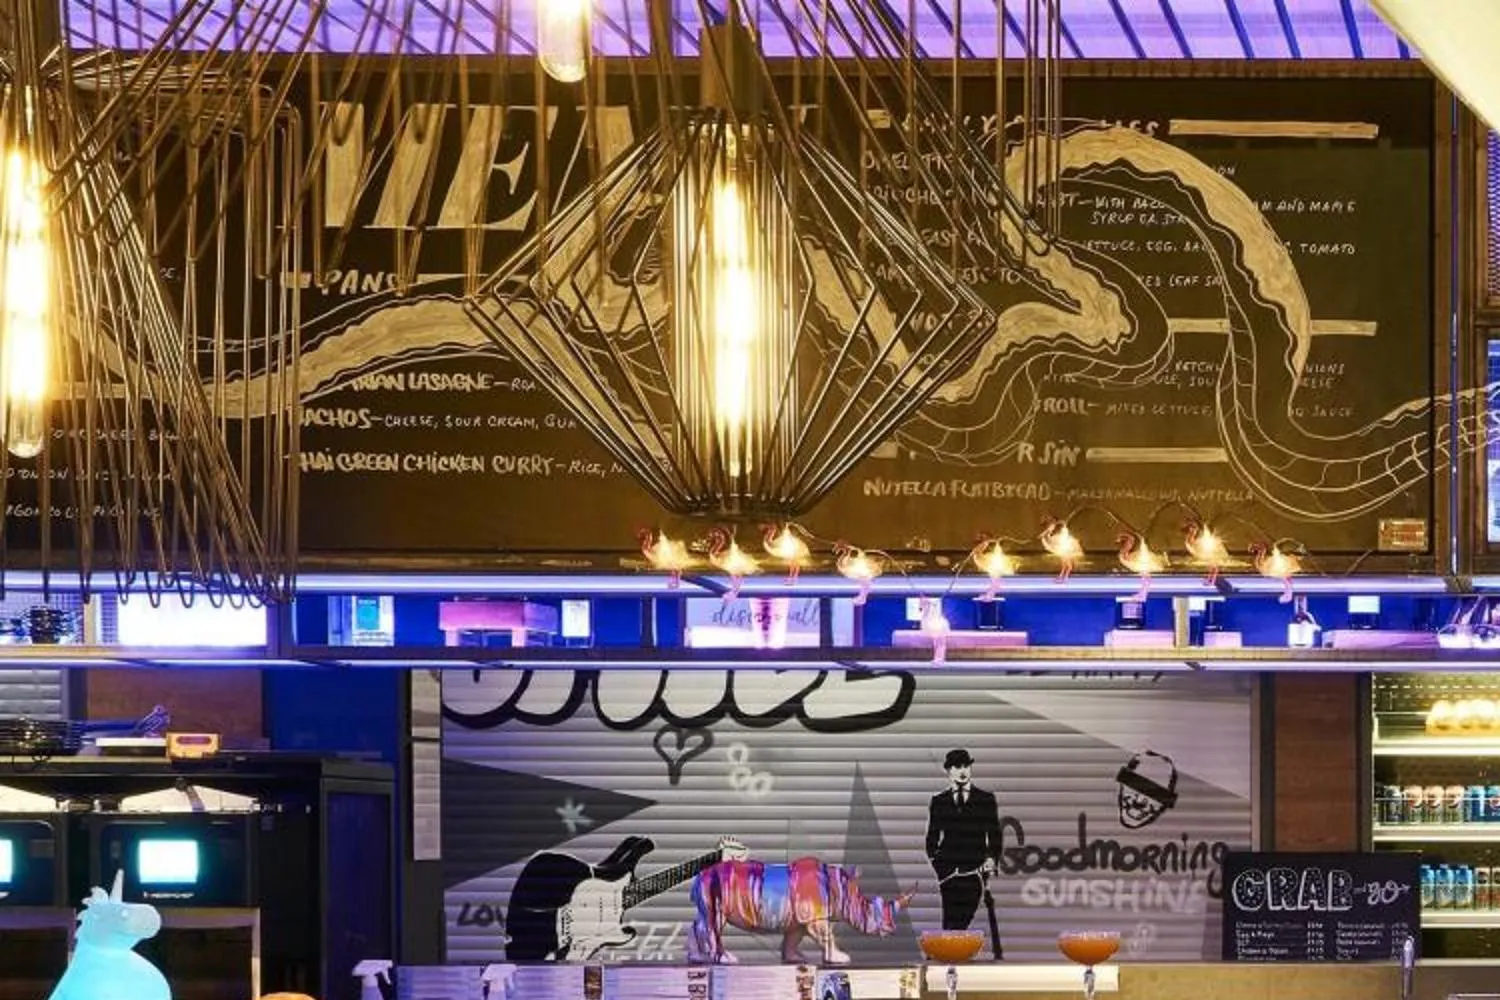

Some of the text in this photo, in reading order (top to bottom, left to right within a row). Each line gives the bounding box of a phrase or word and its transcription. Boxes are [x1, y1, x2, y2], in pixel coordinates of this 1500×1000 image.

[1300, 243, 1355, 255] TOMATO
[408, 372, 494, 392] LASAGNE
[300, 406, 372, 429] ACHOS
[445, 414, 482, 428] SOUR
[336, 452, 399, 473] GREEN
[492, 453, 554, 476] CURRY
[863, 476, 946, 498] NUTELLA
